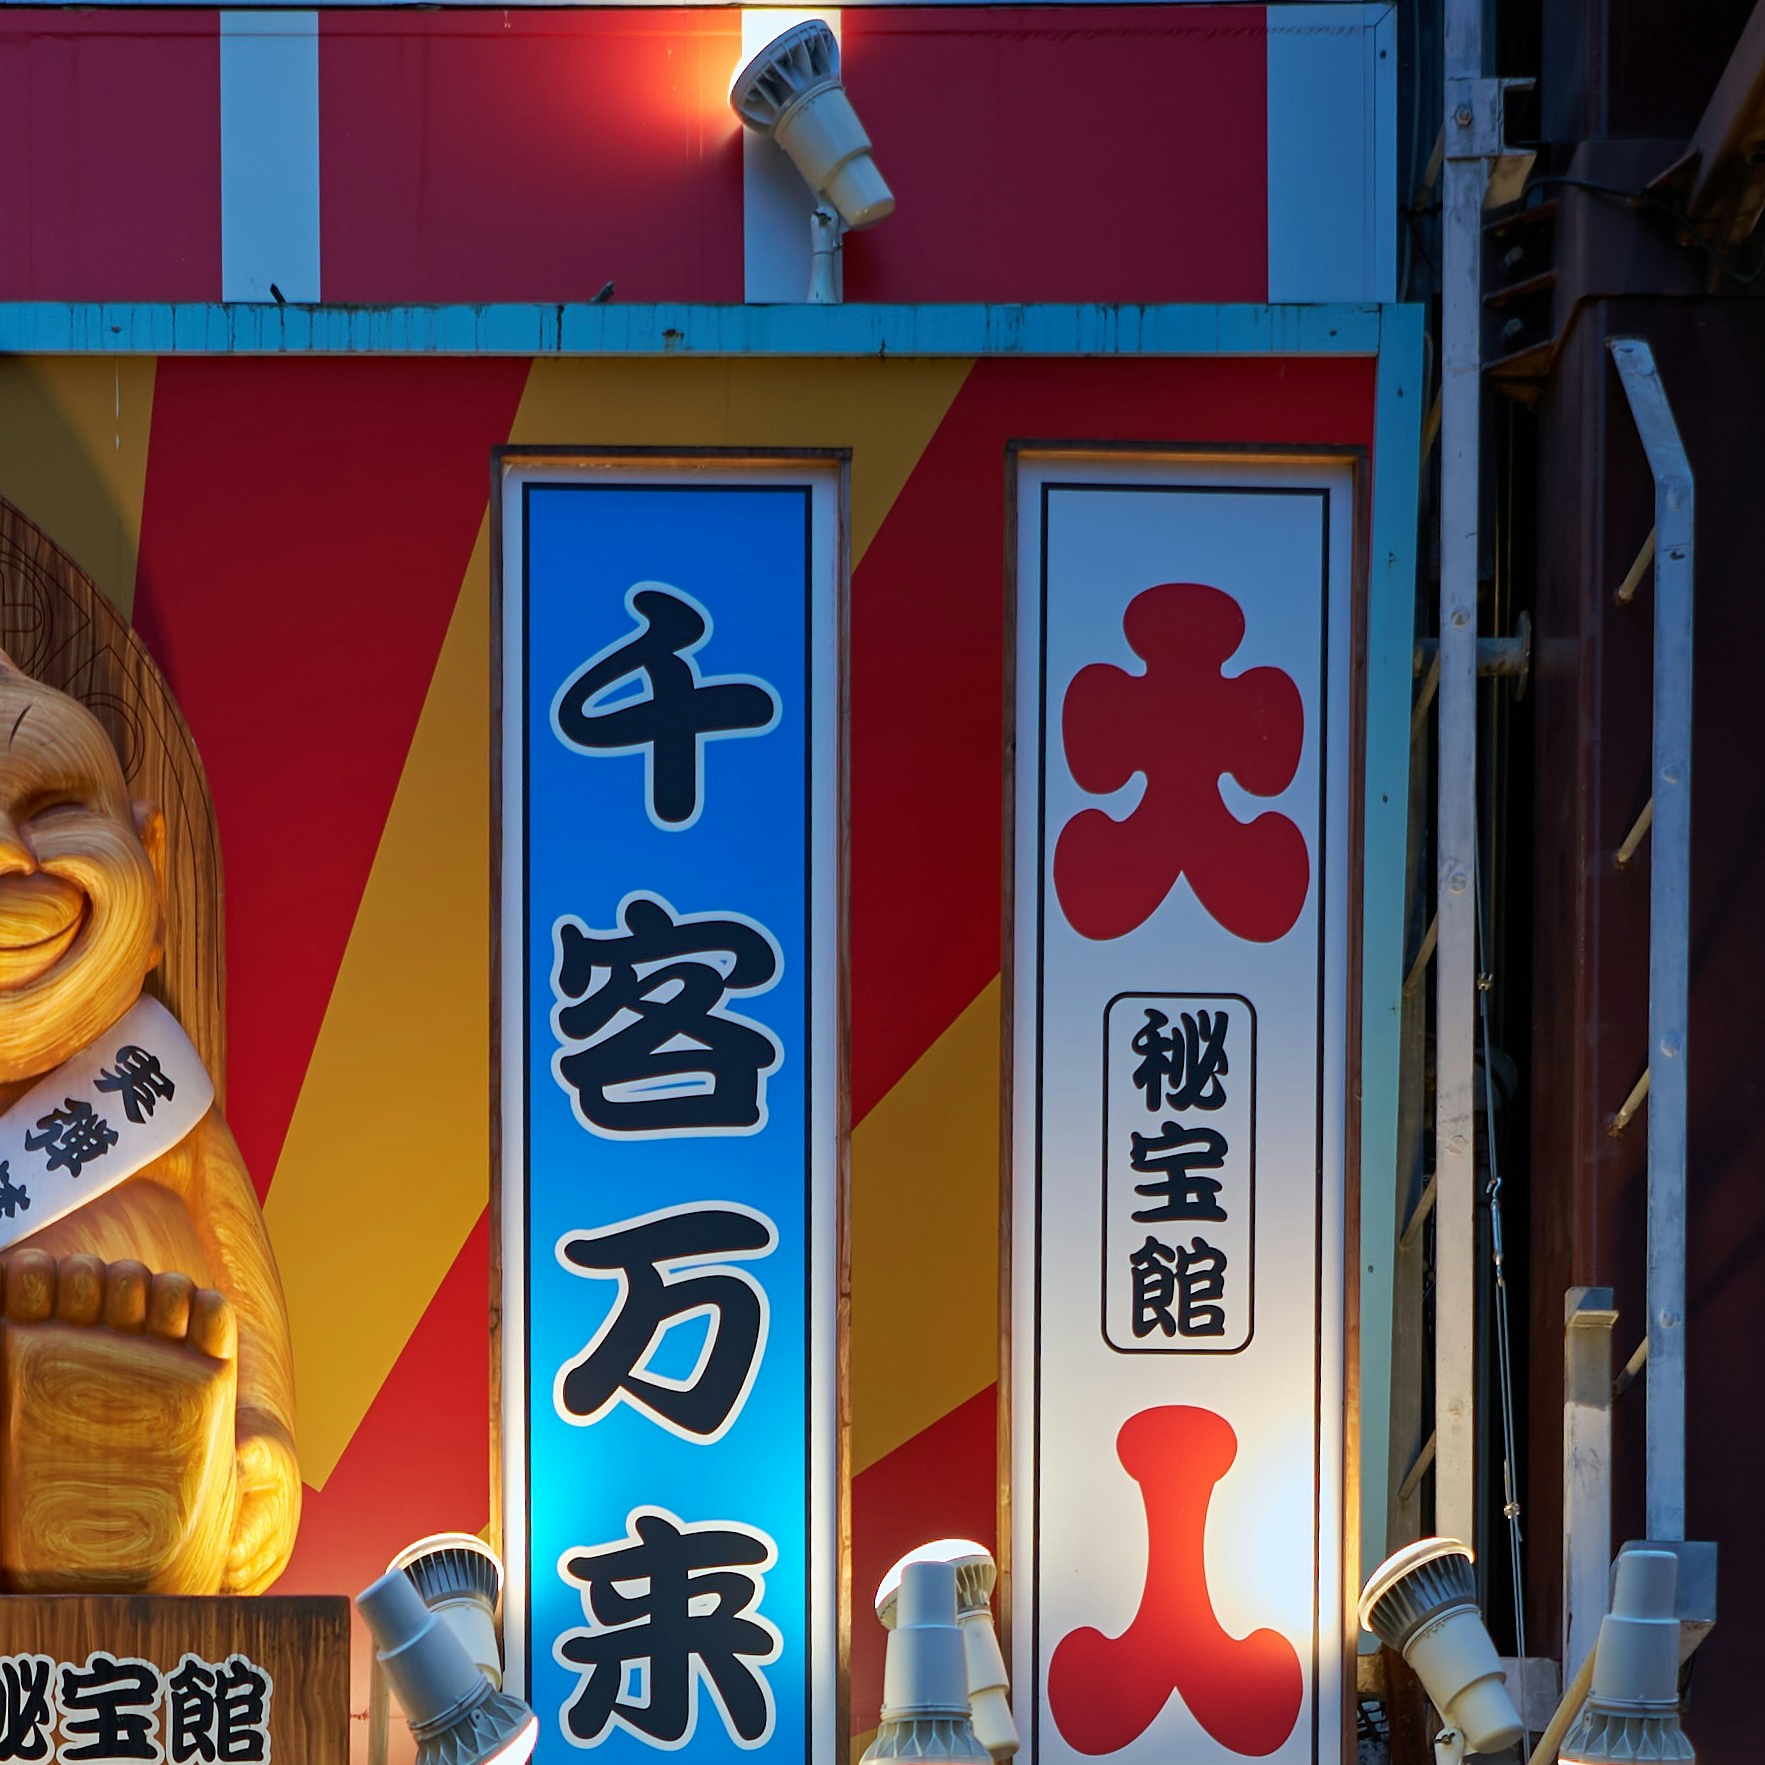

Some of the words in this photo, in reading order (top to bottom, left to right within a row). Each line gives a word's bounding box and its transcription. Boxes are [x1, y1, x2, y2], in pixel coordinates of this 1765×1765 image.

[551, 581, 782, 1751] 千客万来
[1130, 1008, 1230, 1340] 秘宝館
